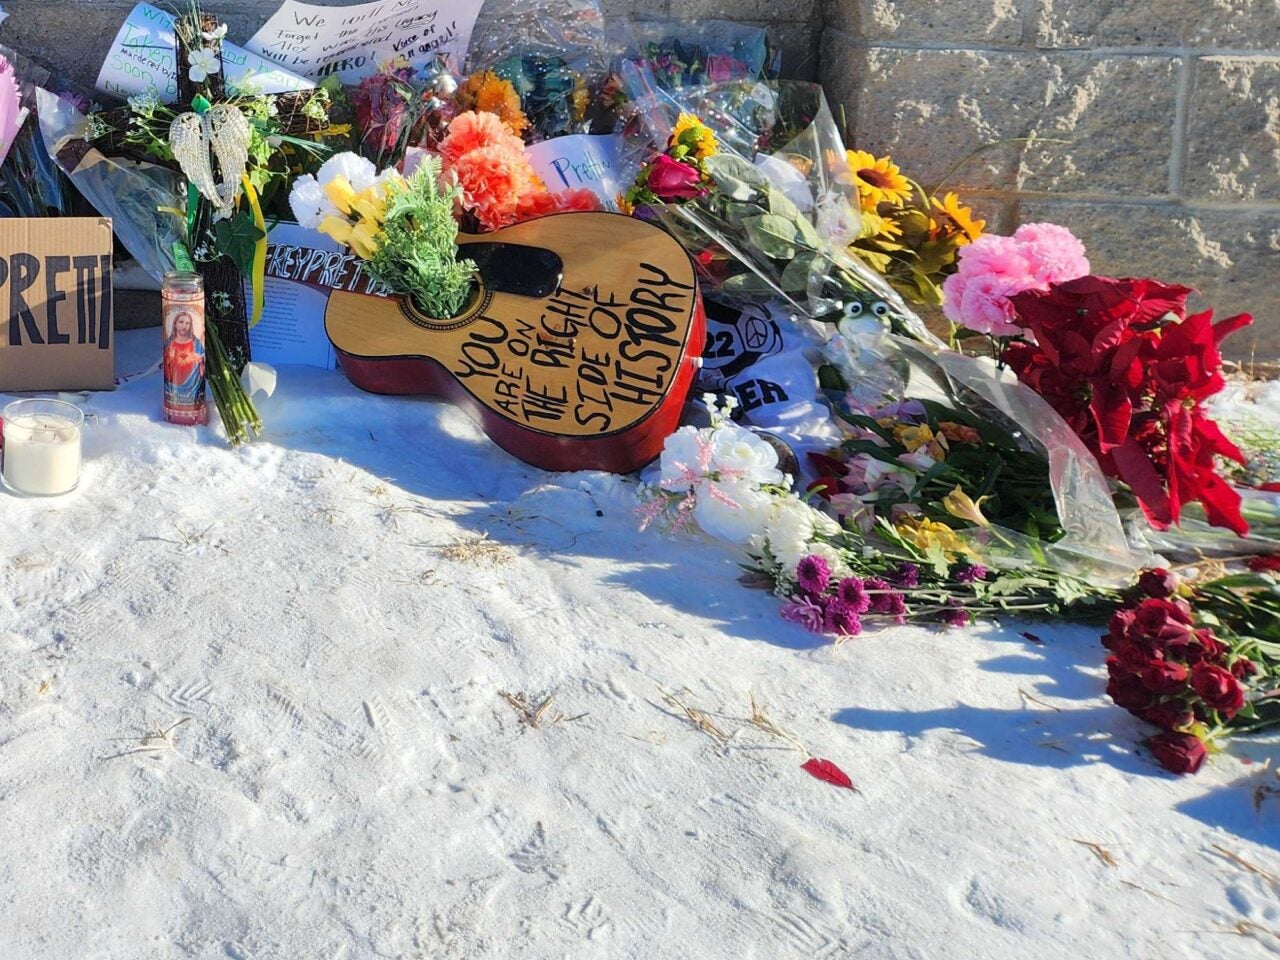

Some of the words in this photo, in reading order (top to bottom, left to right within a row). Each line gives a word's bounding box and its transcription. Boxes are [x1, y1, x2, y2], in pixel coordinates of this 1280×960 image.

[295, 11, 325, 27] We
[262, 47, 288, 62] will
[293, 56, 309, 65] be
[270, 40, 311, 53] Alex
[507, 319, 536, 356] ON
[530, 287, 591, 368] RIGHT
[589, 284, 628, 340] OF
[610, 263, 695, 405] HISTORY
[454, 315, 508, 378] YOU
[494, 364, 523, 416] ARE
[521, 376, 568, 422] THE
[574, 347, 613, 432] SIDE
